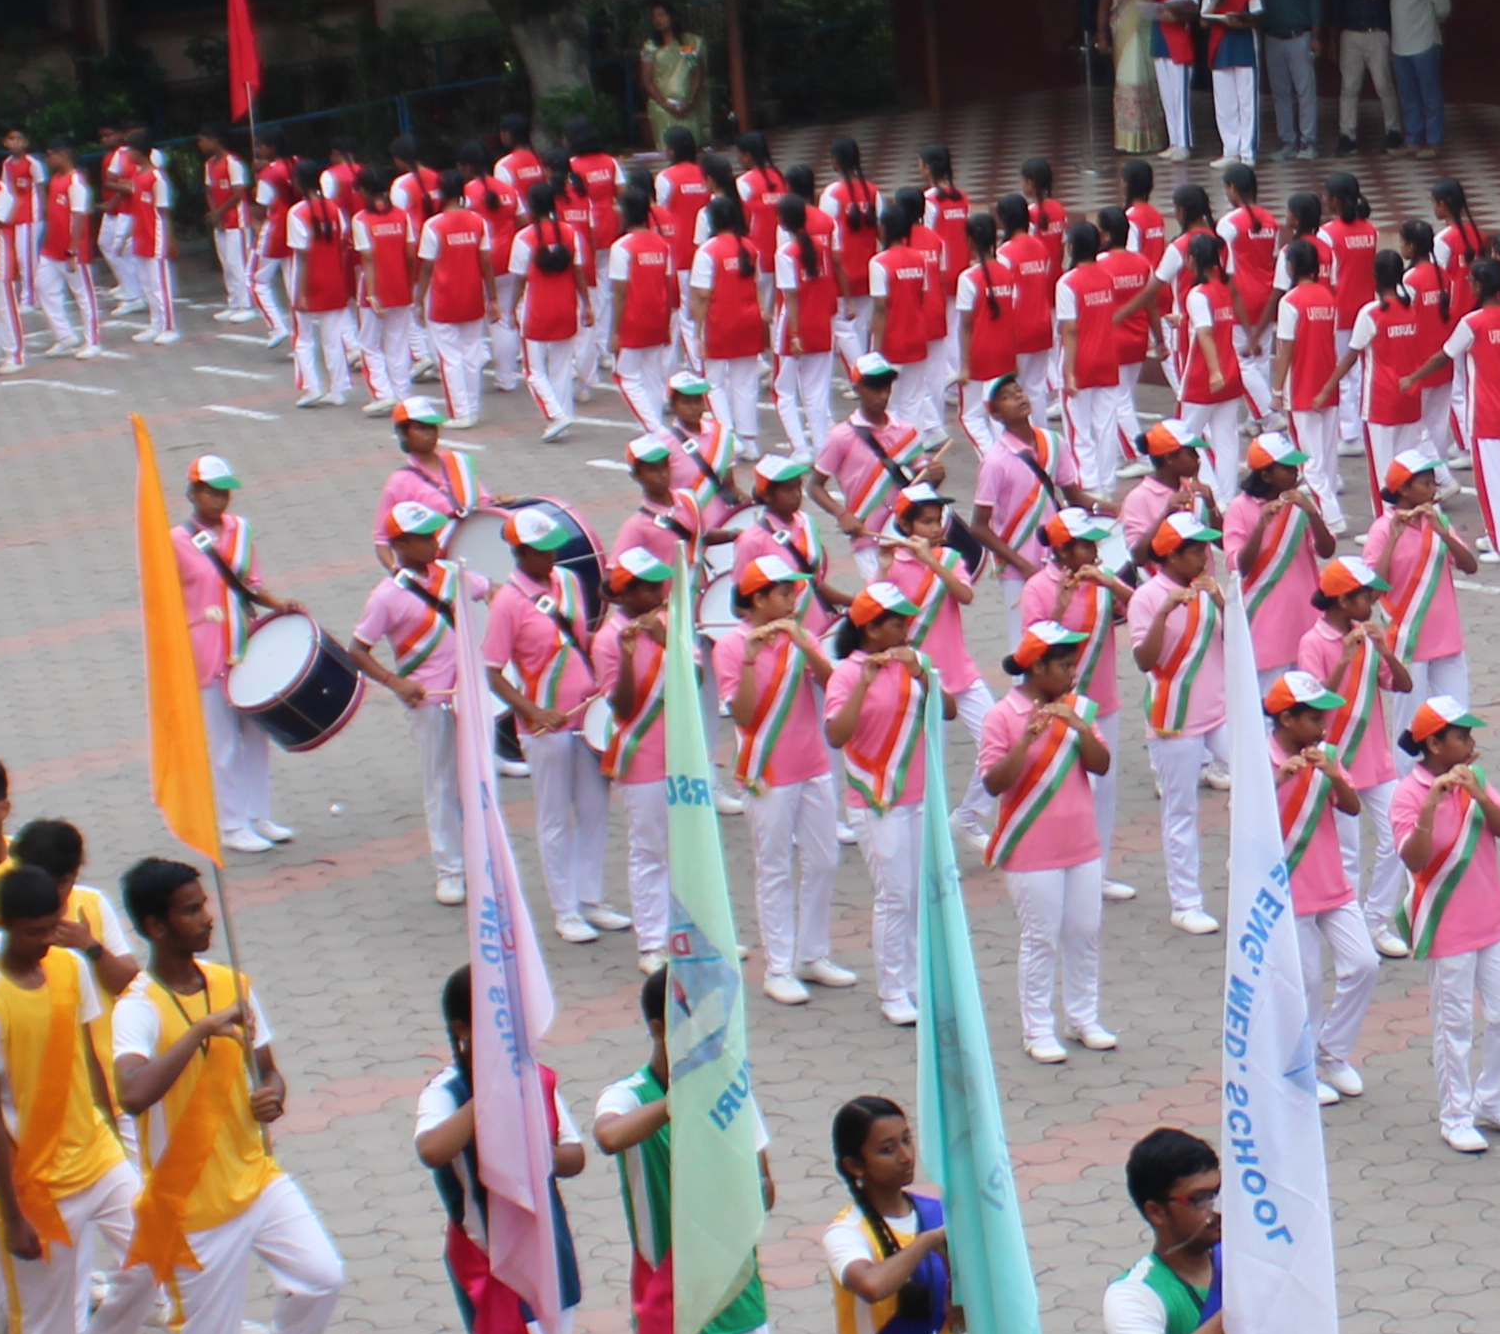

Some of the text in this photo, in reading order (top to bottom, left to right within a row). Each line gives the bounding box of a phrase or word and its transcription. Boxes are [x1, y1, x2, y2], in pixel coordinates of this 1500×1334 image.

[1344, 235, 1374, 249] URSULA
[1113, 274, 1145, 289] URSULA
[1084, 289, 1113, 306] URSULA
[1306, 306, 1335, 321] URSULA
